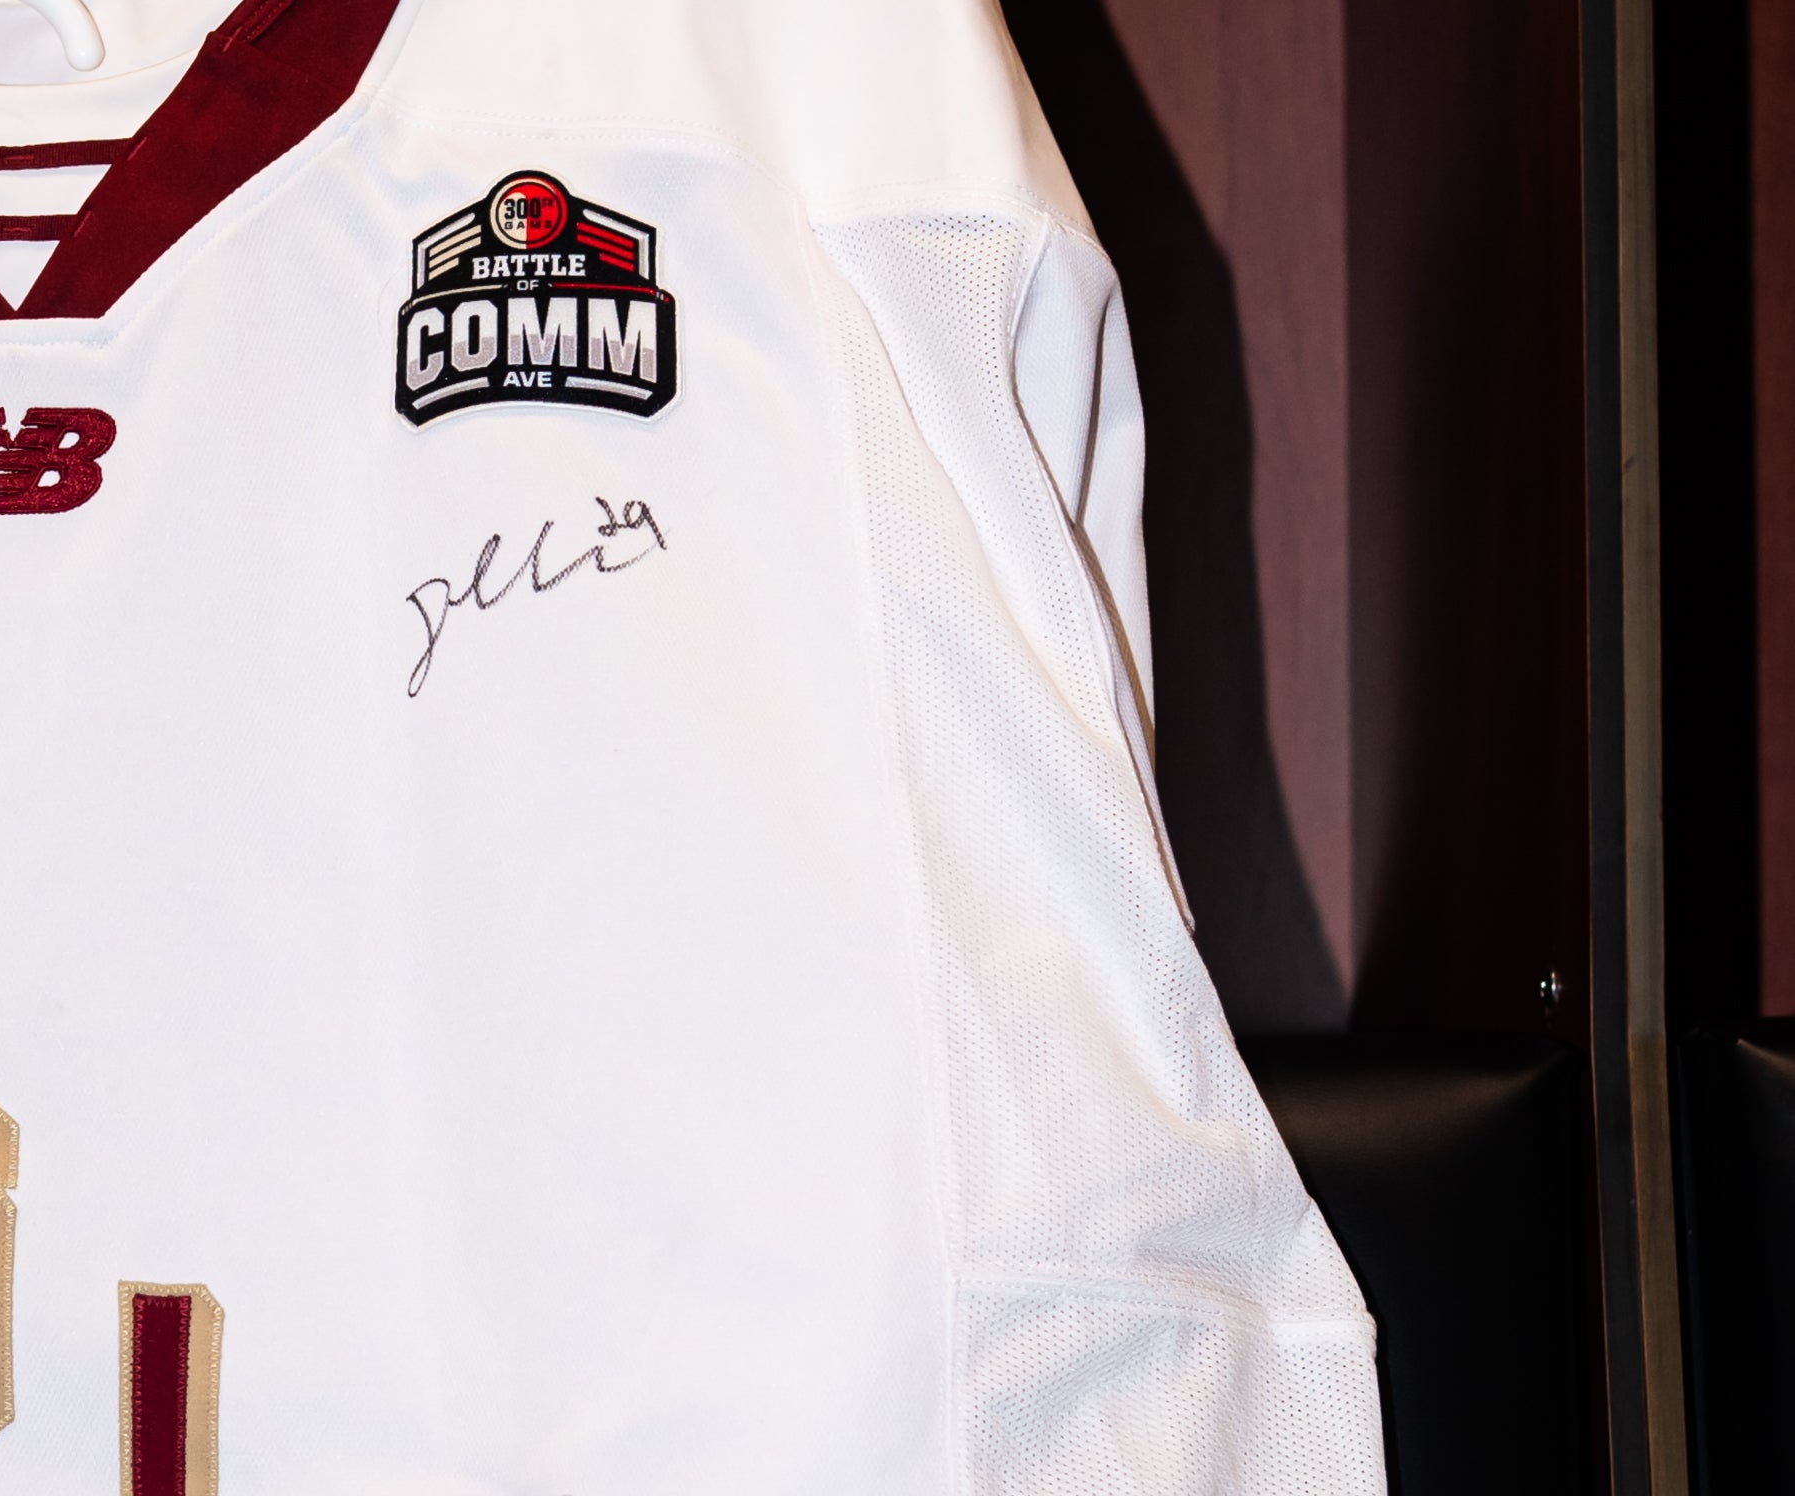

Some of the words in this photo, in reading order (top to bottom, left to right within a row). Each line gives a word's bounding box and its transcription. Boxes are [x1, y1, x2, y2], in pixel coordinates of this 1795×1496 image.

[471, 254, 586, 280] BATTLE
[516, 280, 540, 291] OF
[406, 297, 658, 392] COMM
[502, 371, 553, 388] AVE
